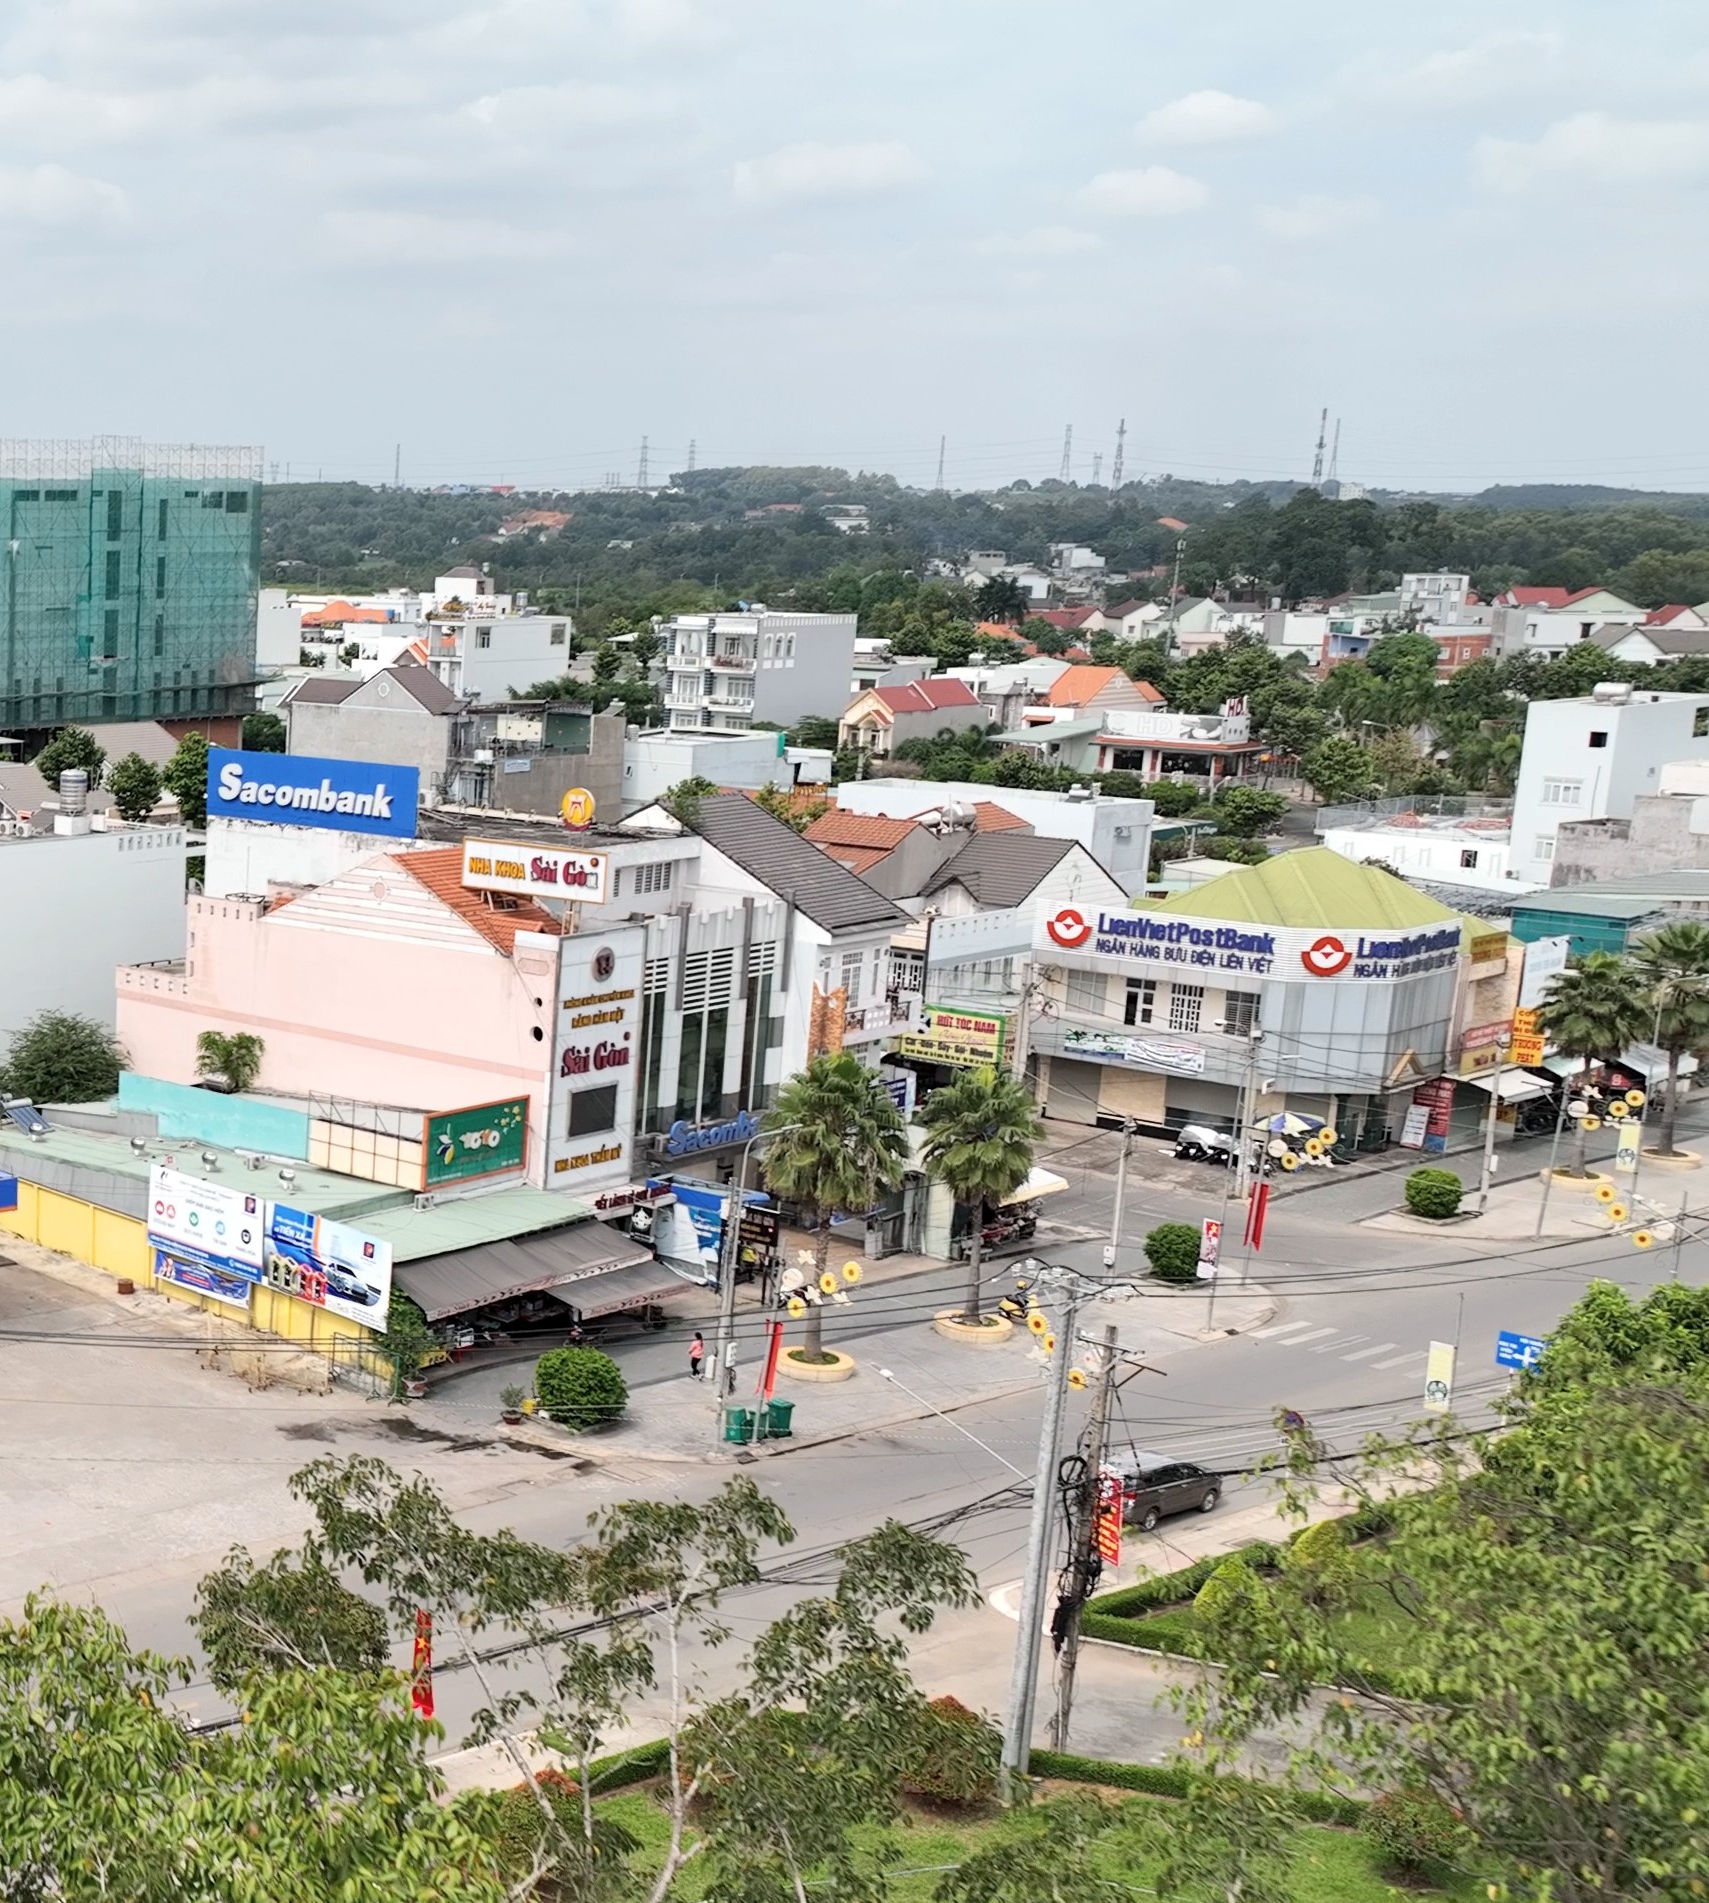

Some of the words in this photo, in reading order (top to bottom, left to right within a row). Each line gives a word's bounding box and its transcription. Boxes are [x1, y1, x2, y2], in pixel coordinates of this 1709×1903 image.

[218, 763, 394, 819] Sacombank
[469, 857, 492, 876] NHA
[494, 859, 526, 880] KHOA
[1098, 912, 1276, 955] LienVietPostBank
[1096, 938, 1126, 956] NGÂN
[1130, 940, 1160, 959] HÀNG
[1219, 953, 1244, 970] LIÊN
[1247, 956, 1274, 974] VIỆT
[561, 1046, 591, 1078] Sài
[593, 1041, 629, 1071] Gòn
